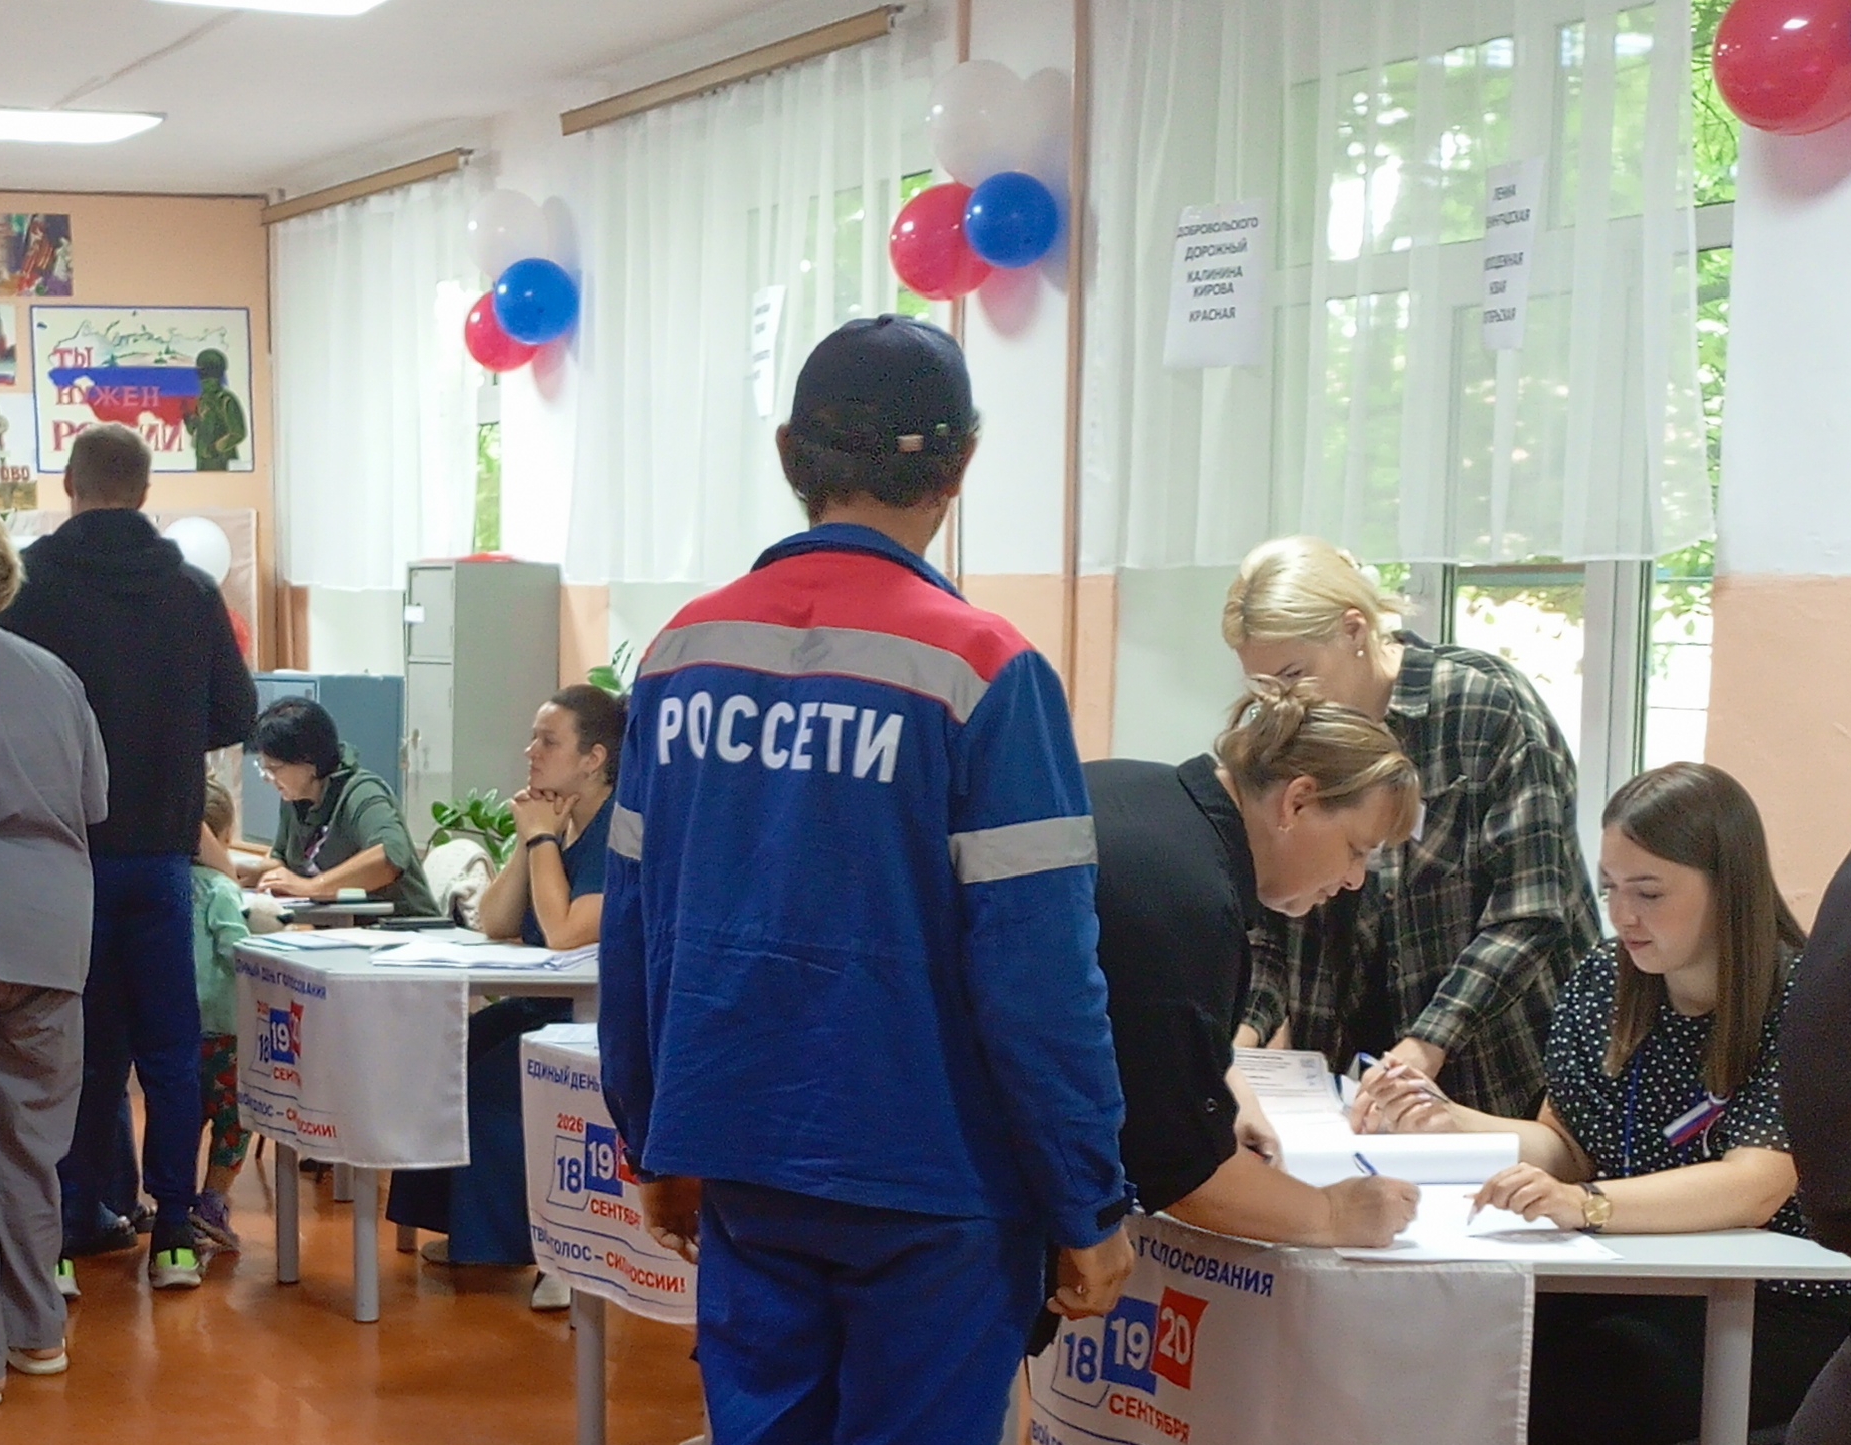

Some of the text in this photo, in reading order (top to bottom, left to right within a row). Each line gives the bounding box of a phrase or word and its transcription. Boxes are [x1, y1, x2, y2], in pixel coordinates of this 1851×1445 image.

[1184, 237, 1248, 262] ДОРОЖНЫЙ
[1187, 265, 1244, 283] КАЛИНИНА
[1193, 282, 1234, 298] КИРОВА
[1189, 306, 1237, 322] КРАСНАЯ
[52, 346, 94, 369] ТЫ
[55, 386, 161, 408] НУЖЕН
[657, 691, 904, 784] РОССЕТИ
[271, 1021, 291, 1051] 19
[527, 1058, 571, 1085] ЕДИНЫЙ
[556, 1112, 585, 1134] 2026
[556, 1155, 583, 1194] 18
[588, 1140, 615, 1181] 19
[1063, 1306, 1191, 1384] 18 19 20
[1109, 1393, 1191, 1445] СЕНТЯБРЯ
